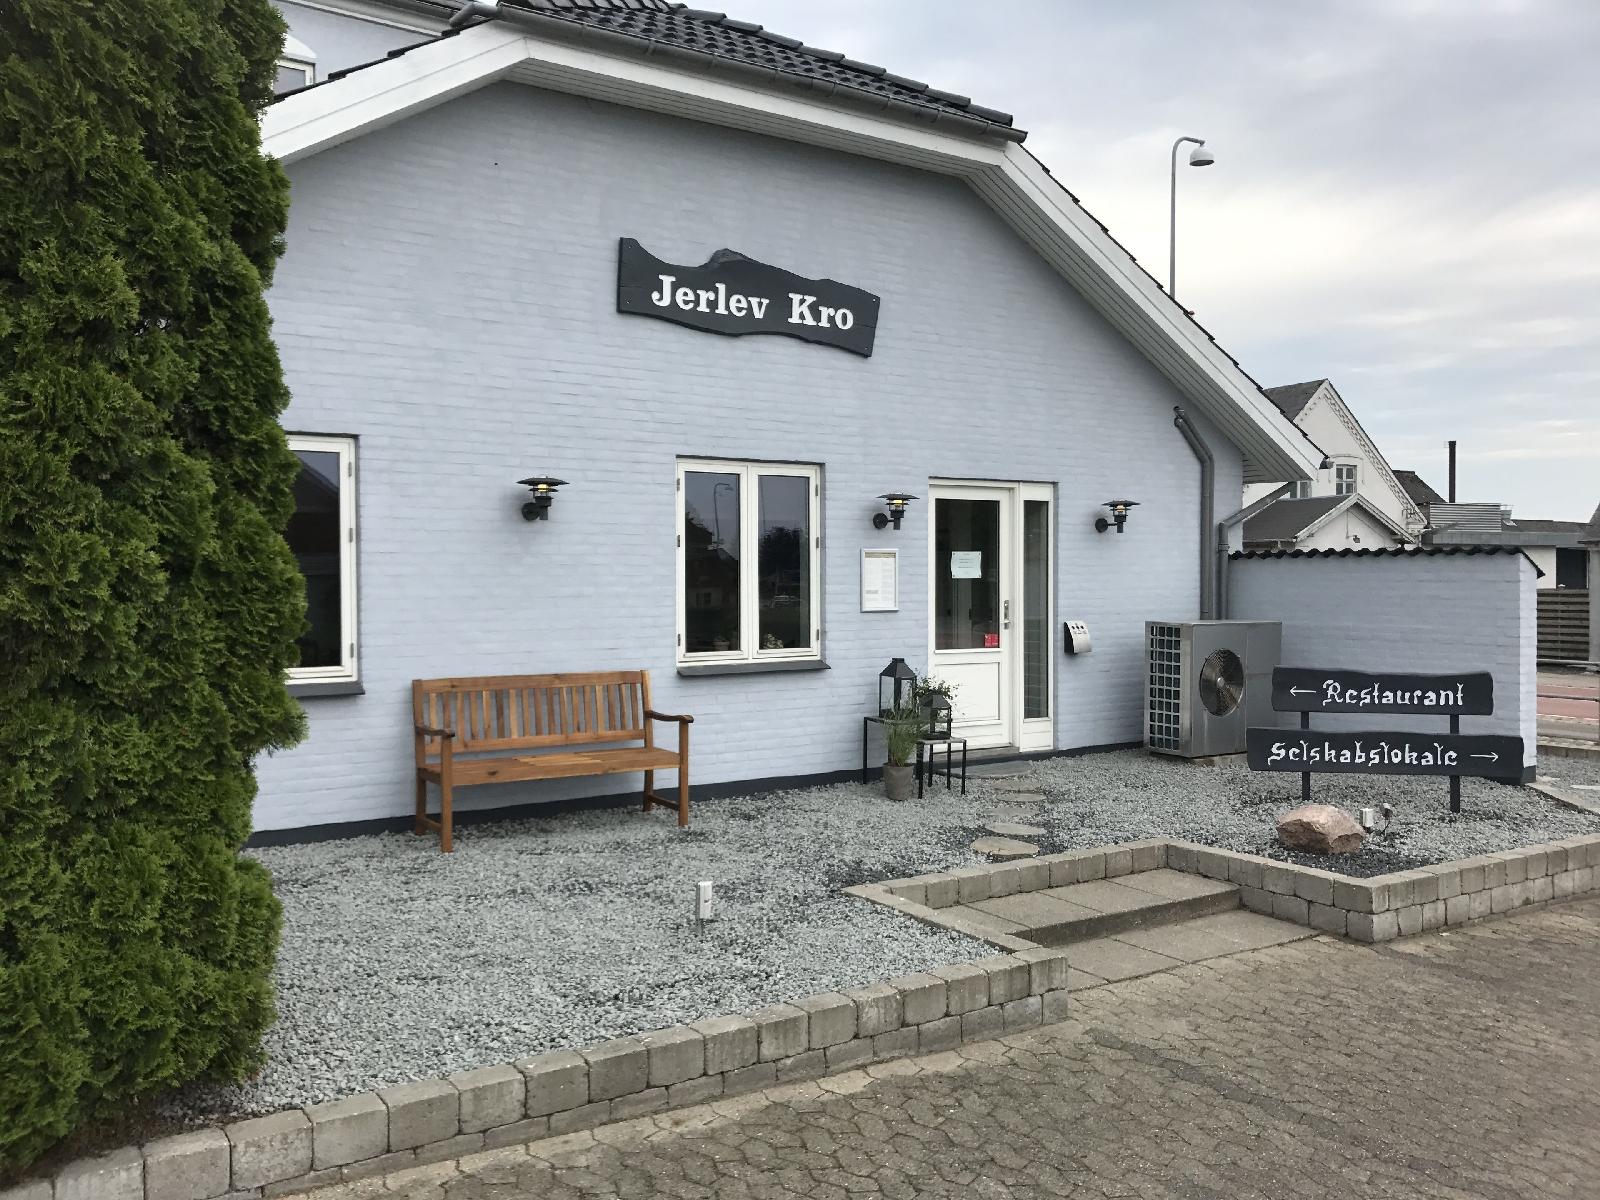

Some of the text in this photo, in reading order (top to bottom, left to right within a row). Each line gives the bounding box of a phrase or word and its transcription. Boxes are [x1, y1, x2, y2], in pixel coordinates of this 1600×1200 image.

[651, 274, 854, 330] Jerlev Kro
[1322, 679, 1464, 707] Restaurant
[1267, 740, 1458, 766] Selskabslokale
